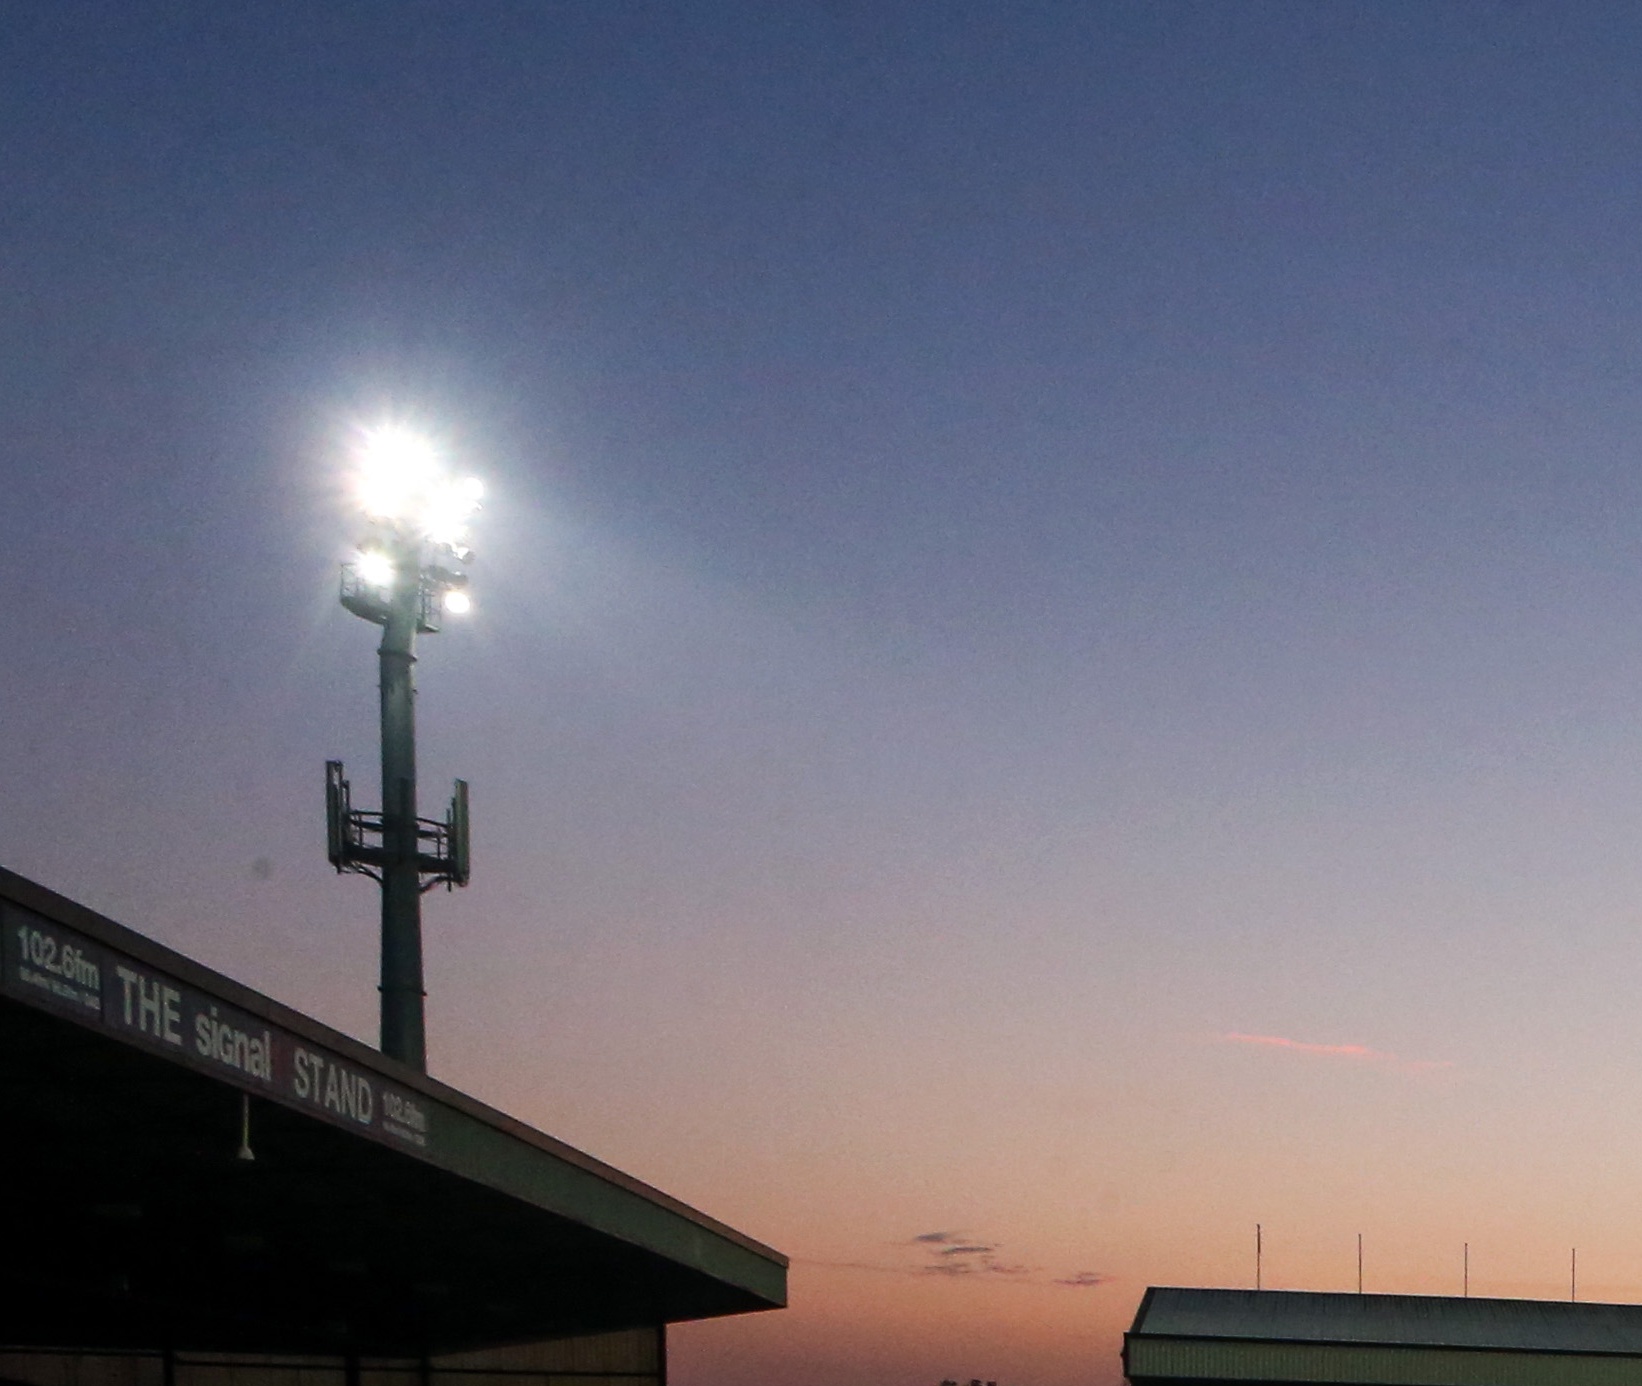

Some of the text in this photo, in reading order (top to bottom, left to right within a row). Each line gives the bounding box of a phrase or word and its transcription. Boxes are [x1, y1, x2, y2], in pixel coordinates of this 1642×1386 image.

[18, 926, 101, 992] 102.6fm
[116, 965, 183, 1046] THE
[196, 1006, 271, 1081] signal
[294, 1048, 373, 1124] STAND
